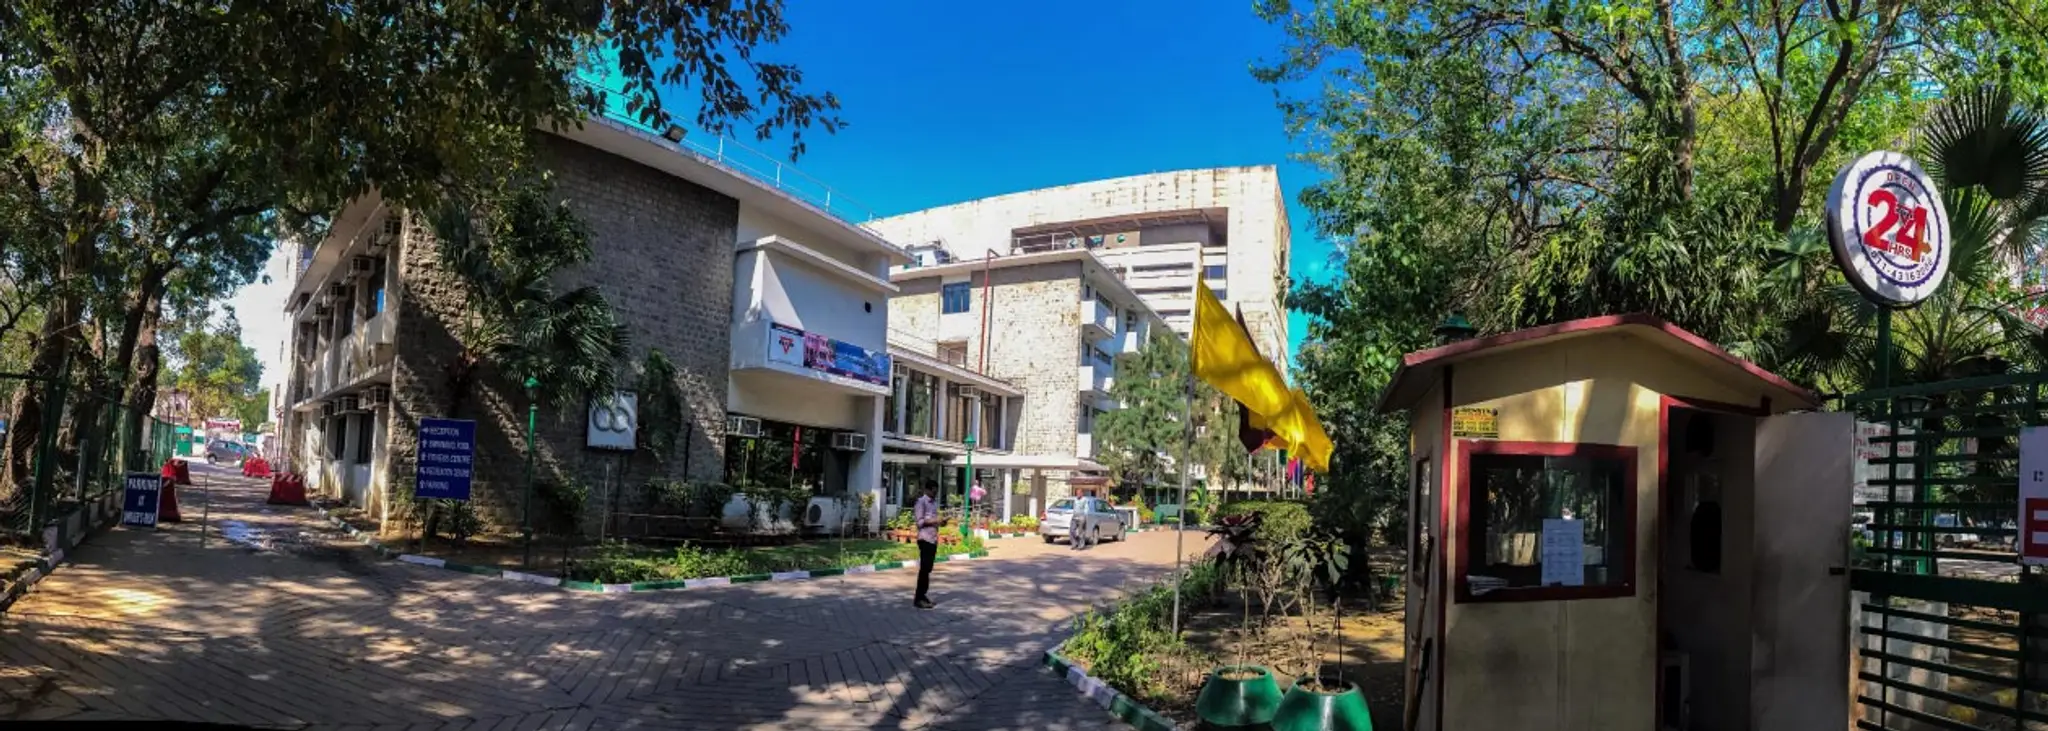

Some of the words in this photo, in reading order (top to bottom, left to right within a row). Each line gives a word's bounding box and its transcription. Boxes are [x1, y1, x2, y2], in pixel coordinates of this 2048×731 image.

[1887, 172, 1916, 191] OPEN
[1863, 188, 1932, 262] 24
[1888, 243, 1912, 259] HRS
[429, 427, 460, 436] RECEPTION
[128, 478, 157, 490] PARKING
